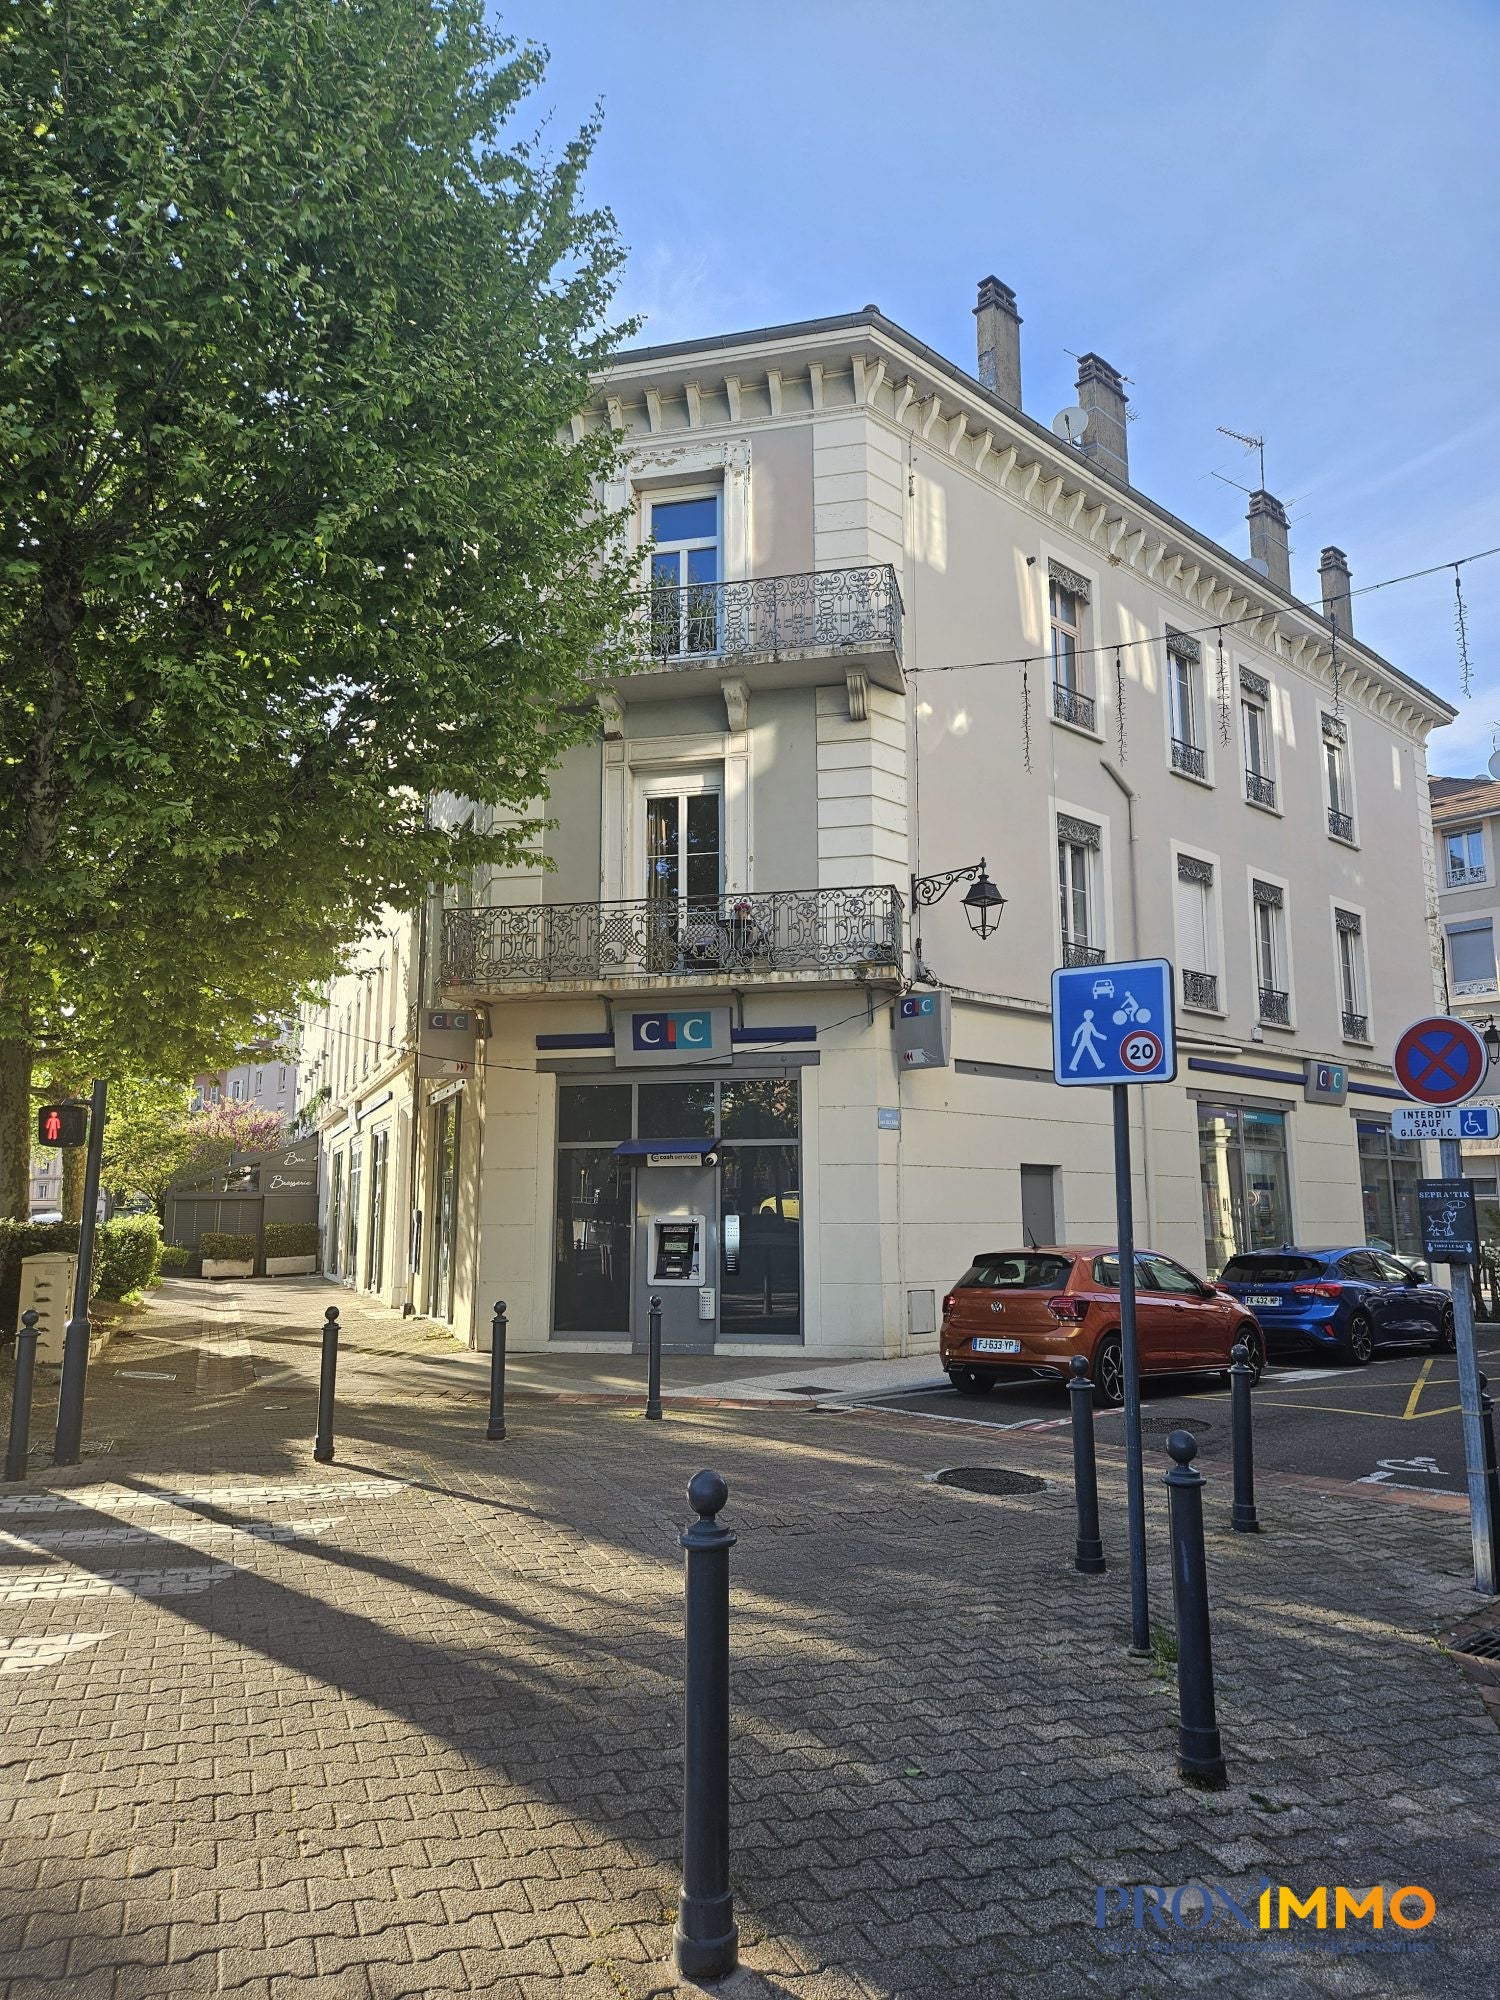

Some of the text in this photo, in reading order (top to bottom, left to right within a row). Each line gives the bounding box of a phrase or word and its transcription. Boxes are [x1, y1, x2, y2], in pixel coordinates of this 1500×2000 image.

[904, 998, 932, 1017] CIC
[432, 1014, 465, 1028] CIC
[640, 1019, 703, 1043] CIC
[1130, 1043, 1153, 1059] 20
[1319, 1070, 1341, 1088] CIC
[1403, 1110, 1451, 1119] INTERDIT
[1414, 1119, 1441, 1128] SAUF
[1400, 1127, 1457, 1137] G.I.G.-G.I.C.
[283, 1151, 307, 1166] Bar
[269, 1174, 312, 1189] Brasserie
[978, 1339, 1014, 1350] FJ-633-YP
